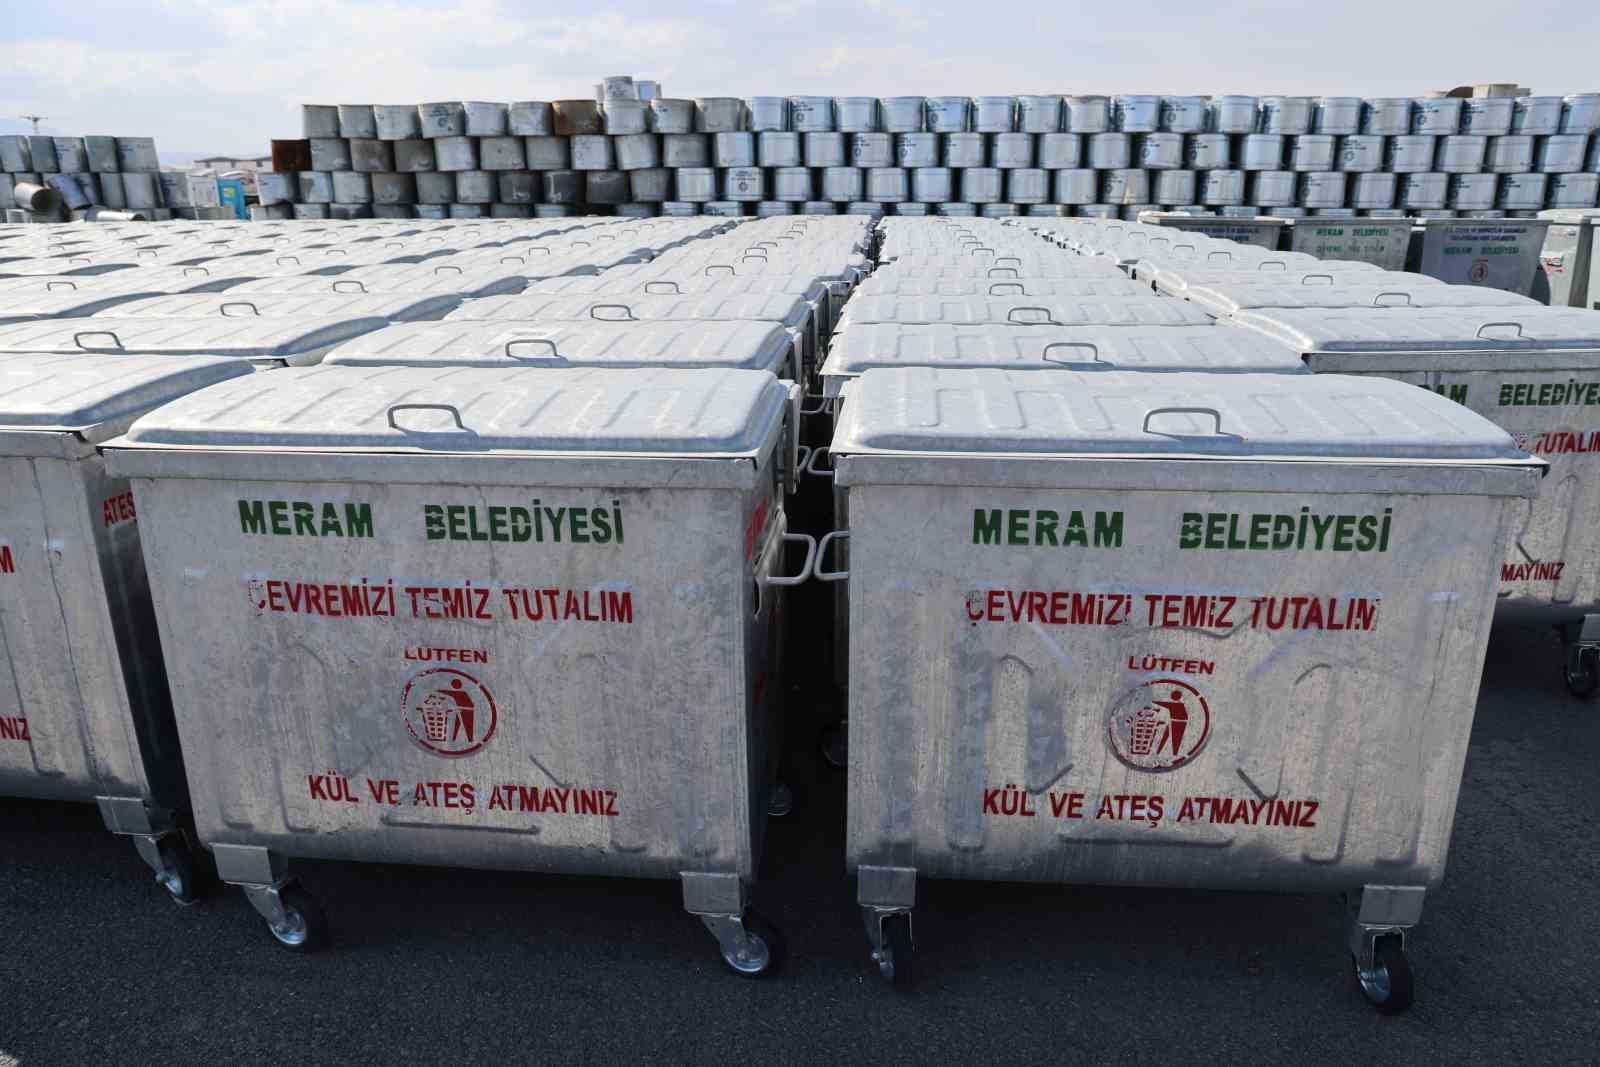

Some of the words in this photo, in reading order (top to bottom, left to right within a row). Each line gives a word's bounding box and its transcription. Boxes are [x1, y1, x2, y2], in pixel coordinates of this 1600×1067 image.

[238, 500, 375, 538] MERAM
[424, 500, 624, 545] BELEDİYESİ
[972, 508, 1124, 548] MERAM
[1179, 507, 1393, 553] BELEDİYESİ
[1501, 562, 1565, 581] MAYINIZ
[405, 580, 493, 620] TEMİZ
[502, 589, 633, 624] TUTALIM
[1144, 594, 1238, 629] TEMİZ
[1128, 655, 1215, 676] LÜTFEN
[308, 770, 359, 803] KÜL
[367, 778, 400, 807] VE
[413, 783, 476, 816] ATEŞ
[489, 784, 620, 817] ATMAYINIZ
[982, 784, 1036, 820] KÜL
[1049, 792, 1086, 820] VE
[1095, 795, 1164, 829] ATEŞ
[1177, 798, 1320, 828] ATMAYINIZ
